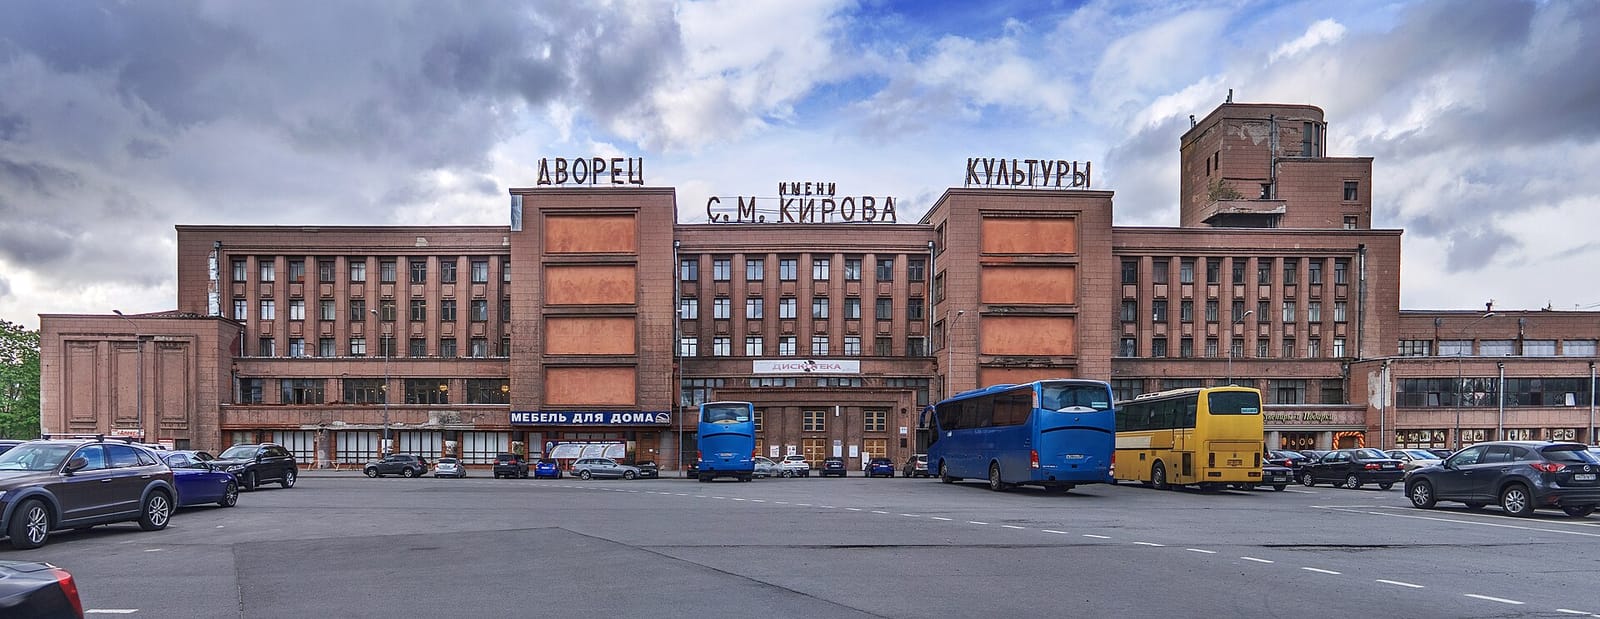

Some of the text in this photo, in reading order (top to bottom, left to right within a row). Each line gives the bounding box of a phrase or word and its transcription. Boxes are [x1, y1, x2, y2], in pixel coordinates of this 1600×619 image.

[537, 157, 644, 186] ДВОРЕЦ
[966, 157, 1091, 188] КУЛЬТУРЫ
[778, 182, 836, 196] ИМЕНИ
[779, 196, 897, 223] КИРОВА
[511, 412, 654, 424] МЕБЕЛЬ ДЛЯ ДОМА
